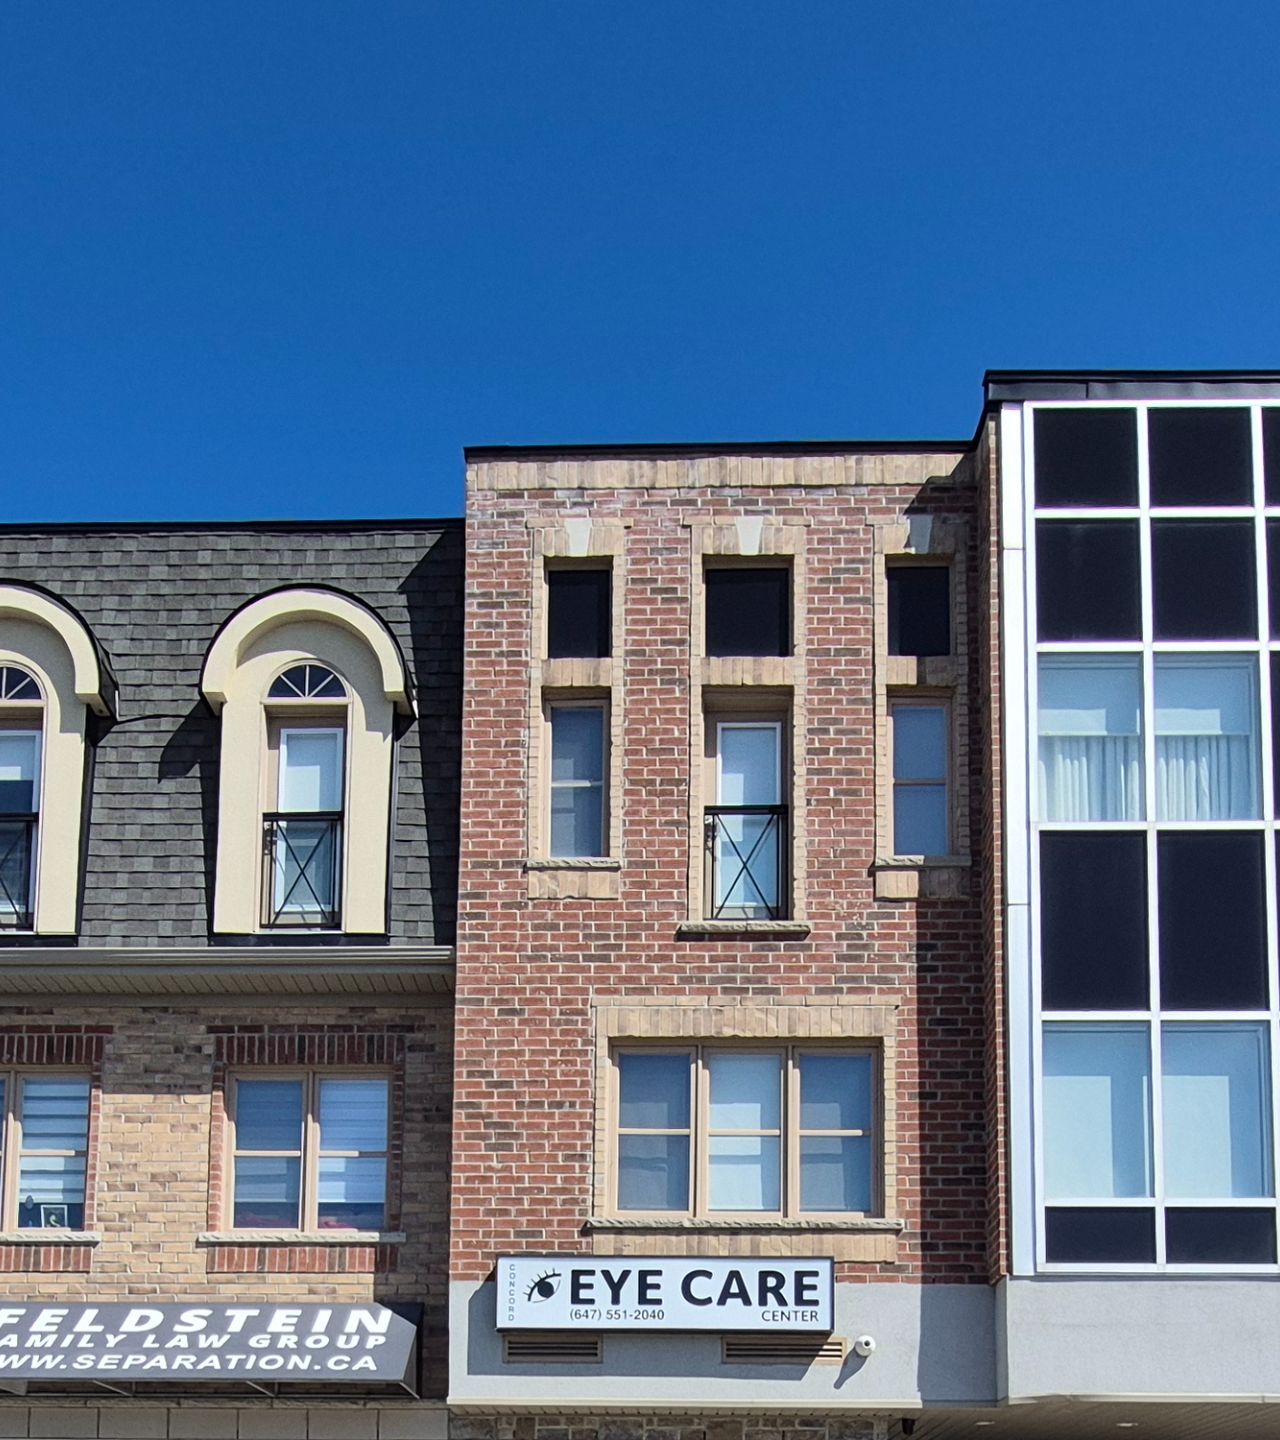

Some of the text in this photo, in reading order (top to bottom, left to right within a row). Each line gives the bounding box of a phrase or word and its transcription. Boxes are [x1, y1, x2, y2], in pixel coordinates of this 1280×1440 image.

[570, 1269, 820, 1307] EYE CARE
[569, 1309, 665, 1322] (647) 551-2040
[761, 1310, 819, 1322] CENTER
[142, 1334, 231, 1349] LAW
[248, 1334, 387, 1349] GROUP
